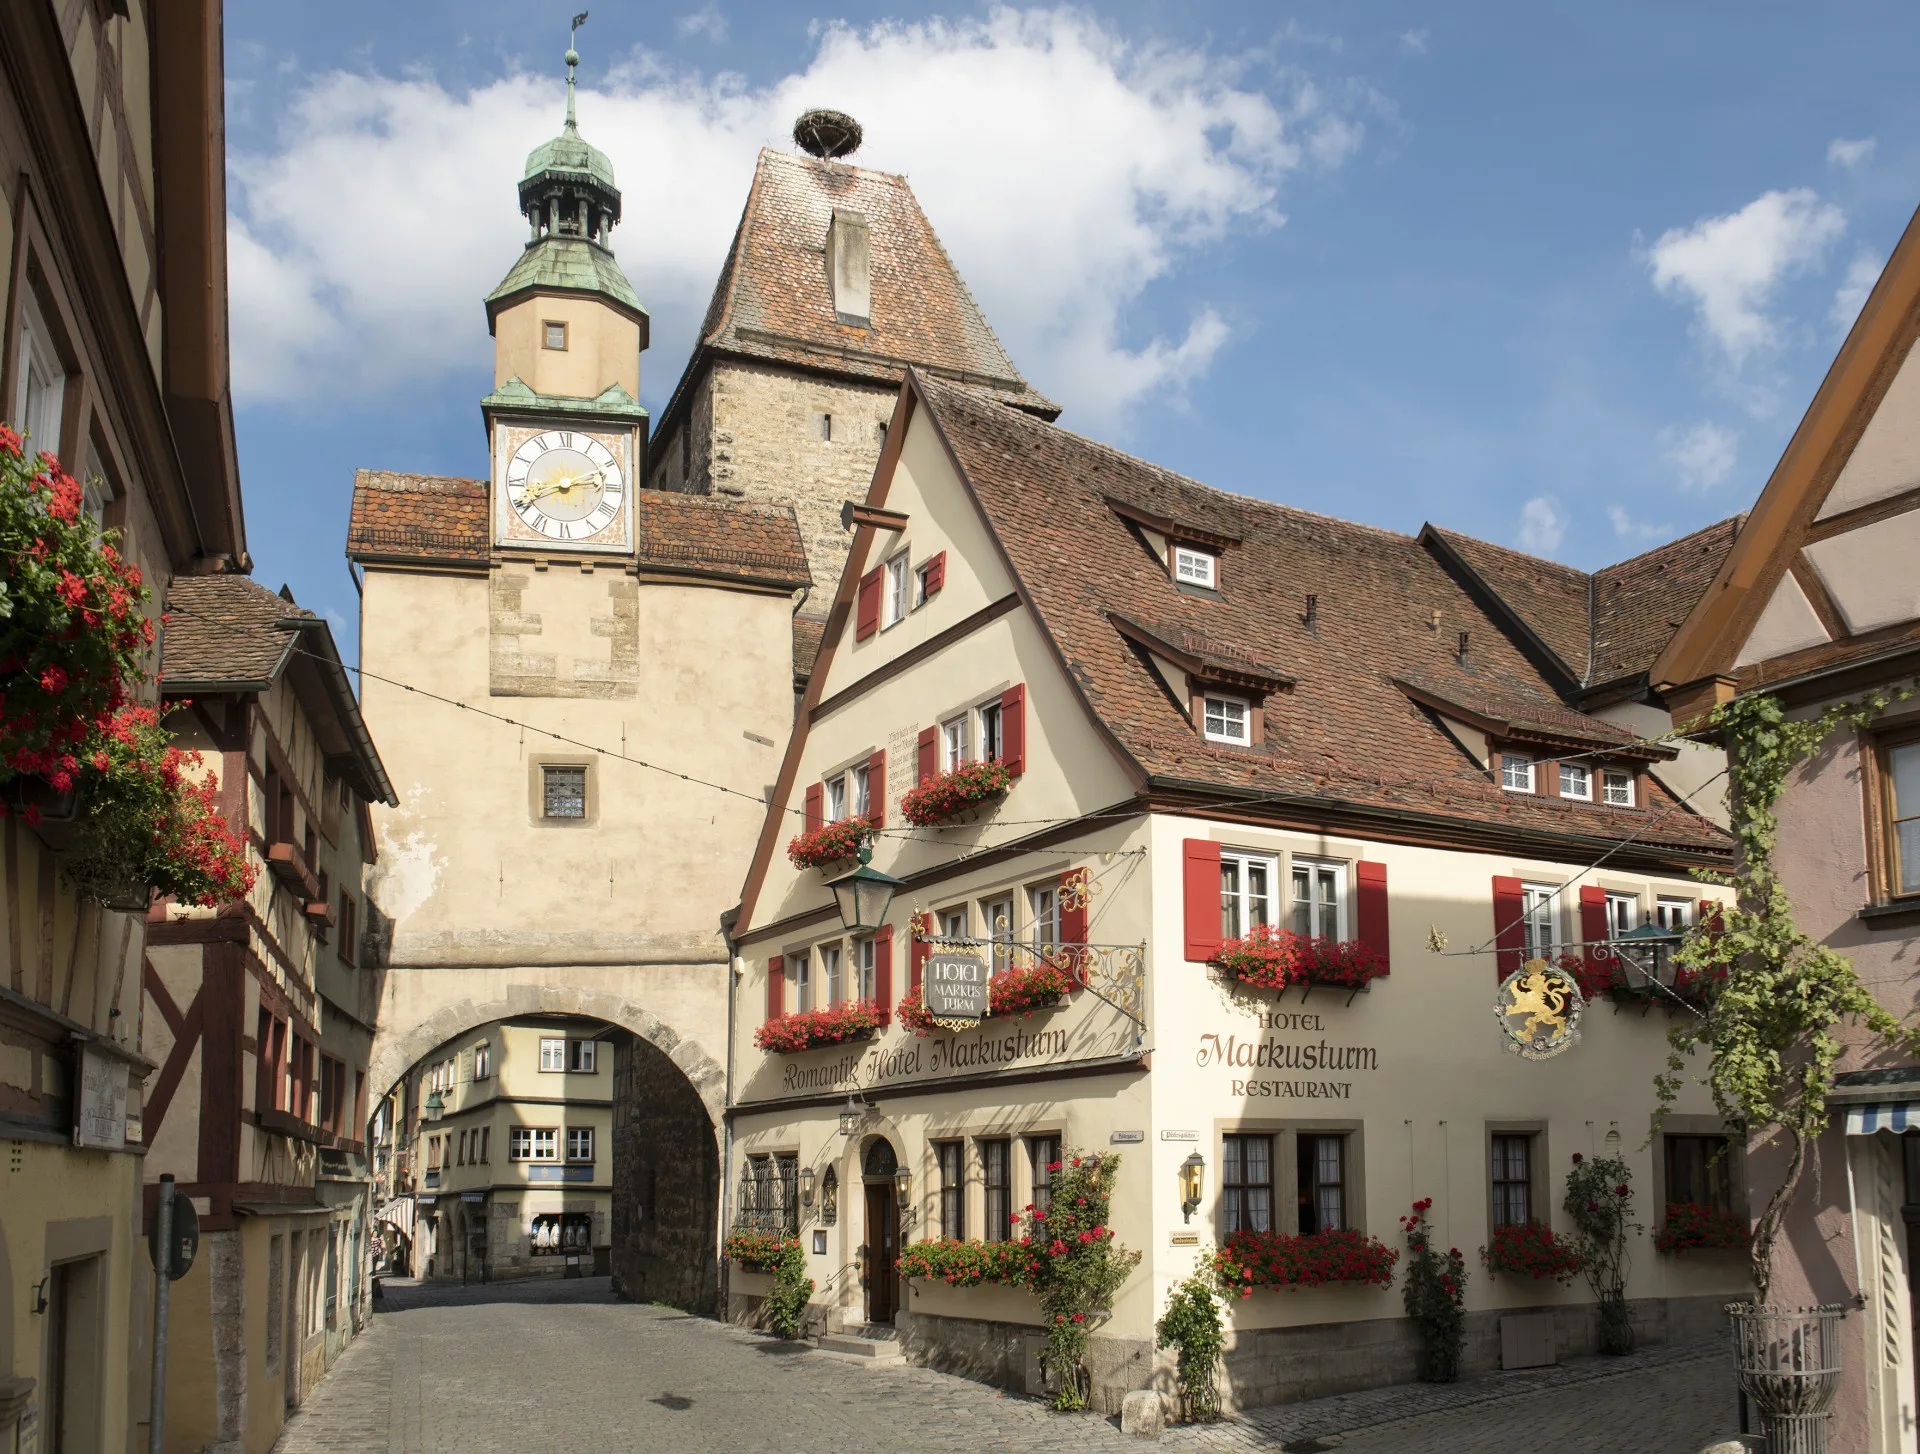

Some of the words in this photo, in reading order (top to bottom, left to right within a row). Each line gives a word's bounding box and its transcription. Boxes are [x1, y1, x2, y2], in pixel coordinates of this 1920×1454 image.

[936, 962, 981, 982] HOTEL
[935, 984, 982, 998] MARKUS
[941, 997, 975, 1011] TURM
[1258, 1012, 1326, 1031] HOTEL
[783, 1055, 859, 1092] Romantik
[866, 1044, 922, 1082] Hotel
[930, 1028, 1069, 1072] Markusturm
[1196, 1032, 1379, 1071] Markusturm
[1231, 1079, 1352, 1099] RESTAURANT
